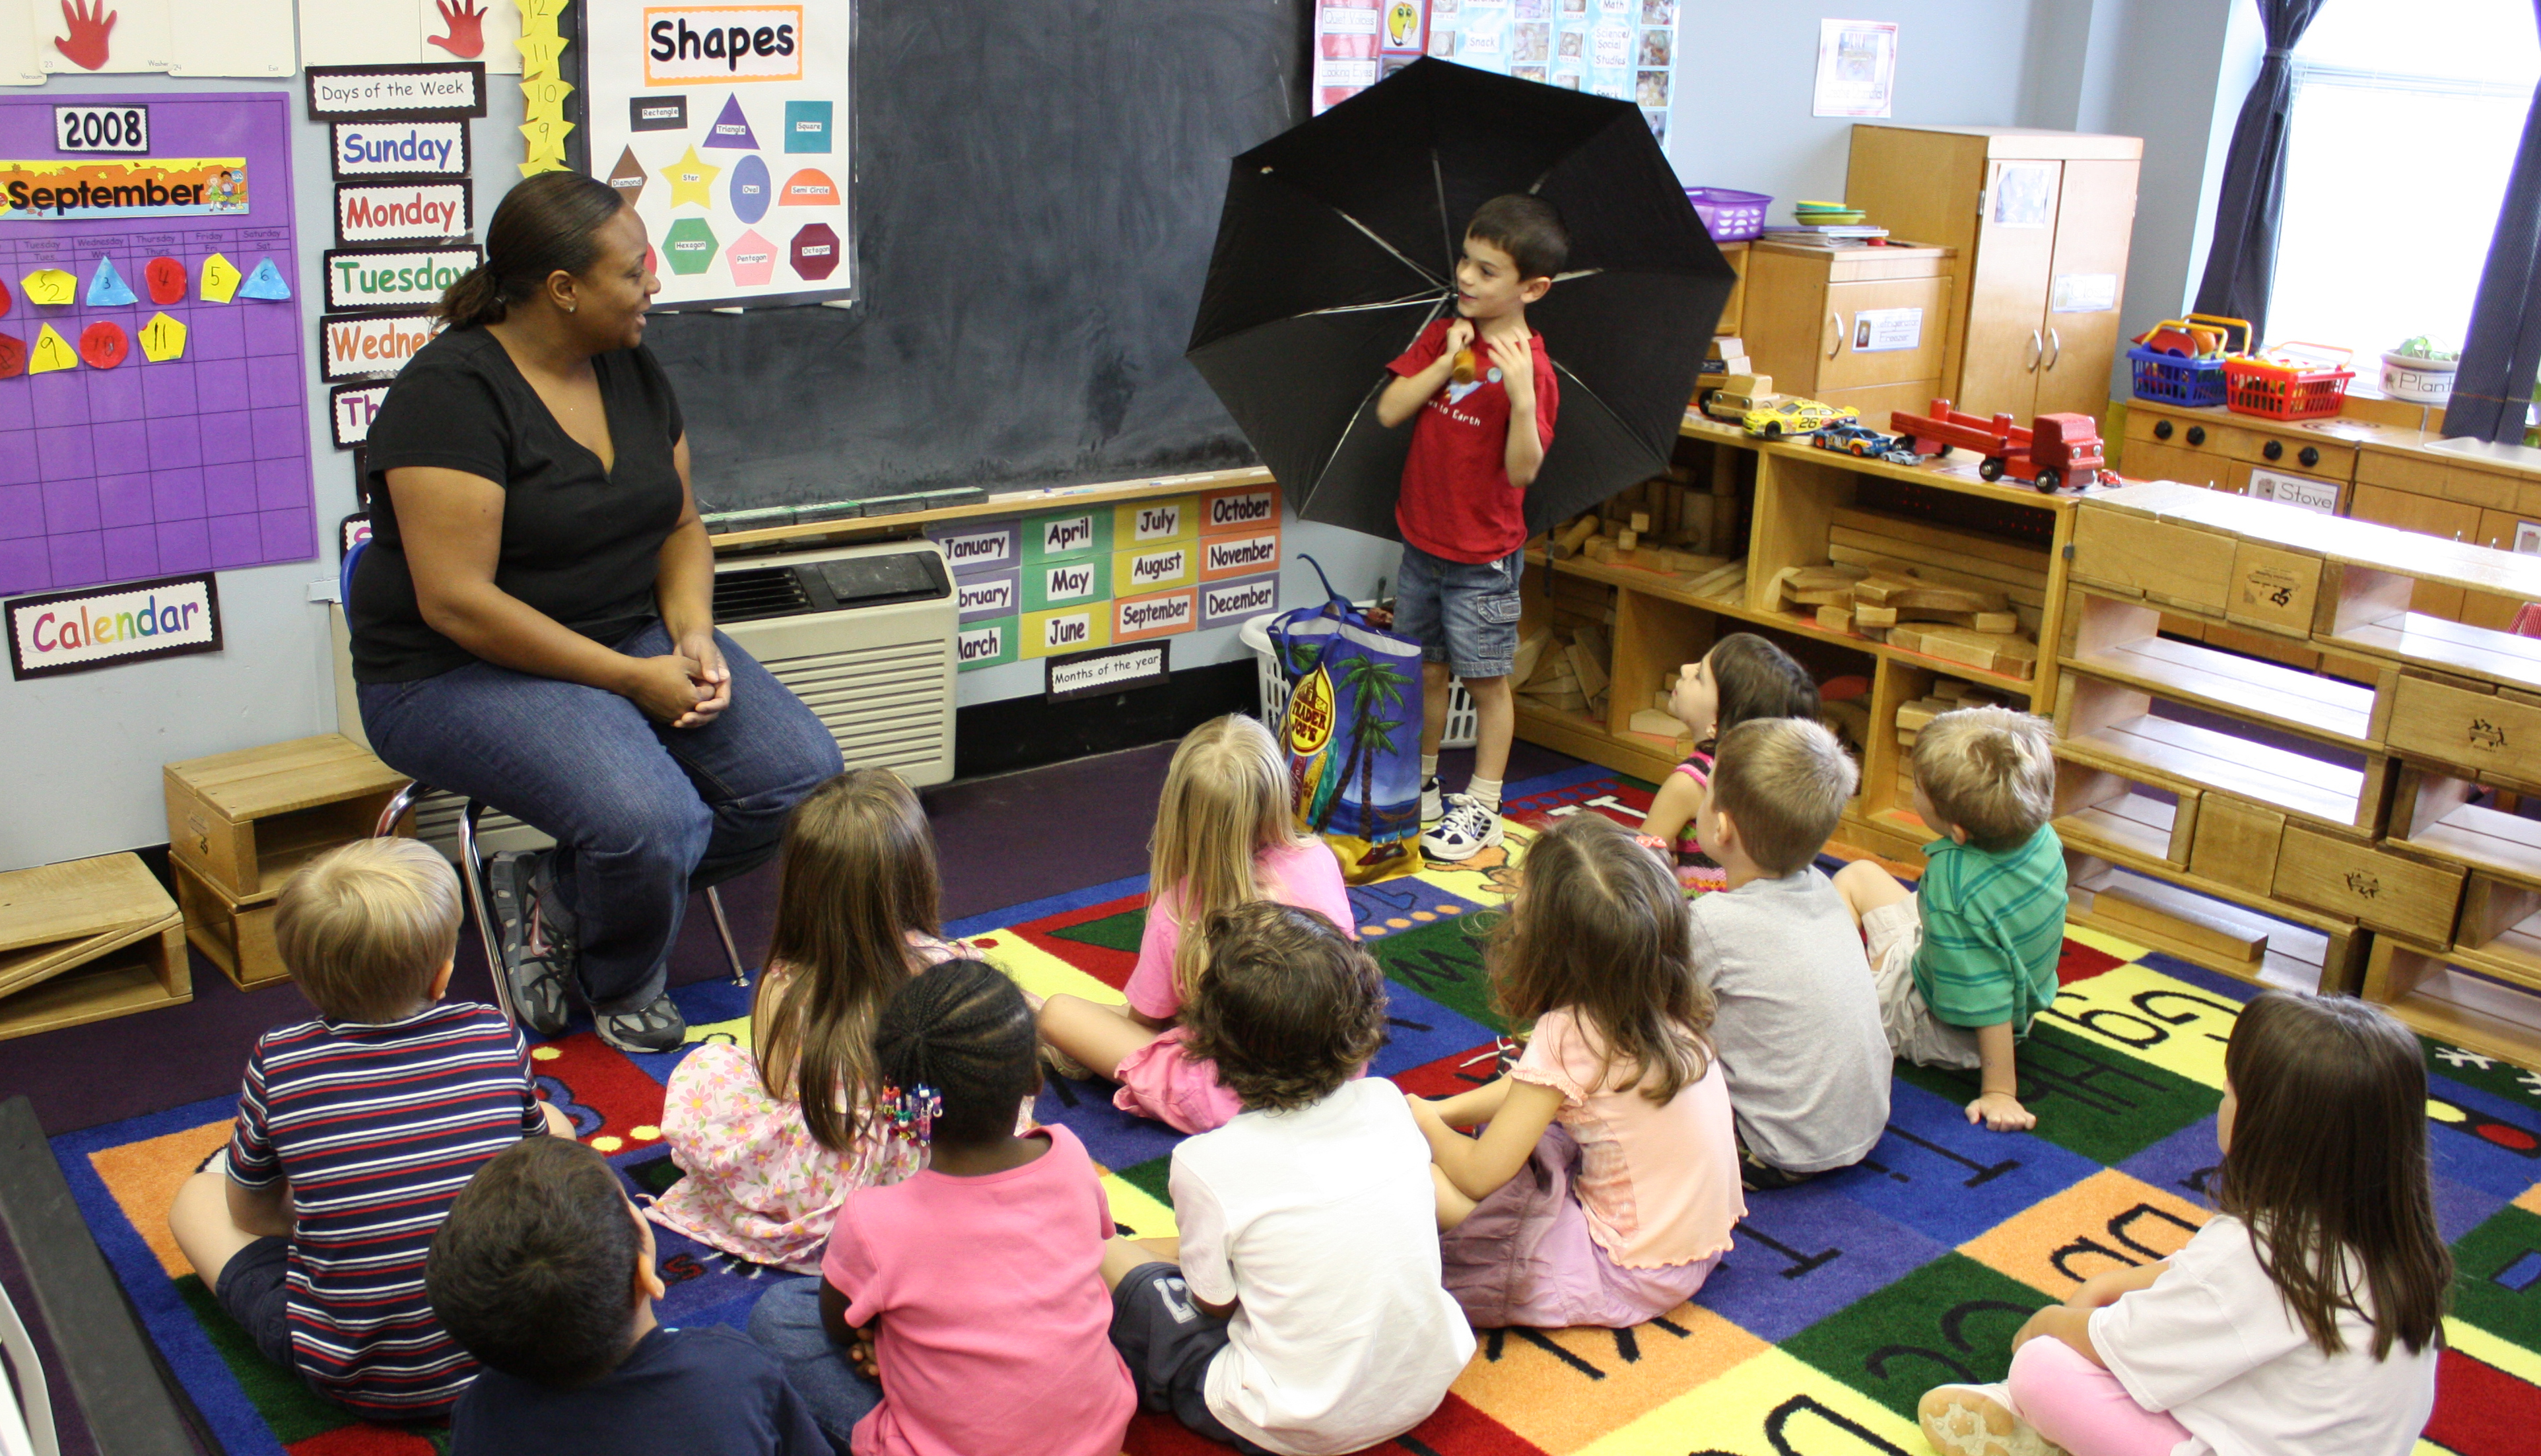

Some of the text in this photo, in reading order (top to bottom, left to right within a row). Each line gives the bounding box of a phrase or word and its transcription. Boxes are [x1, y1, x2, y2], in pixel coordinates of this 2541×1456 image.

[1349, 12, 1374, 25] Voices
[651, 18, 794, 72] Shapes
[1470, 36, 1495, 47] Snack
[1598, 40, 1621, 49] Social
[533, 44, 549, 62] 11
[1596, 55, 1625, 65] Studies
[322, 80, 464, 102] Days of the Week
[537, 84, 557, 103] 10
[643, 108, 678, 116] Rectangle
[64, 111, 141, 148] 2008
[539, 122, 550, 143] 9
[718, 125, 745, 135] Triangle
[797, 123, 821, 131] Square
[343, 129, 453, 170] Sunday
[9, 179, 205, 216] September
[347, 192, 456, 232] Monday
[77, 238, 123, 247] Wednesday
[136, 235, 175, 245] Thursday
[196, 232, 223, 242] Friday
[243, 229, 281, 238] Saturday
[24, 240, 60, 251] Tuesday
[676, 241, 706, 250] Hexagon
[803, 246, 830, 255] Octagon
[737, 253, 767, 263] Pentagon
[104, 277, 111, 289] 3
[158, 269, 169, 286] 4
[211, 266, 221, 286] 5
[261, 269, 269, 281] 6
[154, 322, 166, 351] 11
[331, 322, 439, 362] Wedne
[40, 337, 61, 368] 9
[2400, 372, 2454, 392] Plant
[1439, 404, 1449, 414] to
[1452, 409, 1480, 426] Earth
[1799, 417, 1819, 428] 26
[2279, 482, 2332, 508] Stove
[1213, 496, 1270, 523] October
[1141, 510, 1174, 534] July
[1048, 519, 1089, 549] April
[945, 535, 1005, 560] January
[1210, 541, 1273, 568] November
[1134, 553, 1181, 579] August
[1052, 570, 1089, 593] May
[959, 587, 1009, 607] bruary
[1209, 586, 1271, 615] December
[33, 595, 199, 652] Calendar
[1123, 599, 1188, 628] September
[1050, 620, 1085, 644] June
[1055, 655, 1159, 685] Months of the year
[1292, 700, 1326, 730] TRADER
[1292, 719, 1318, 742] JOE'S
